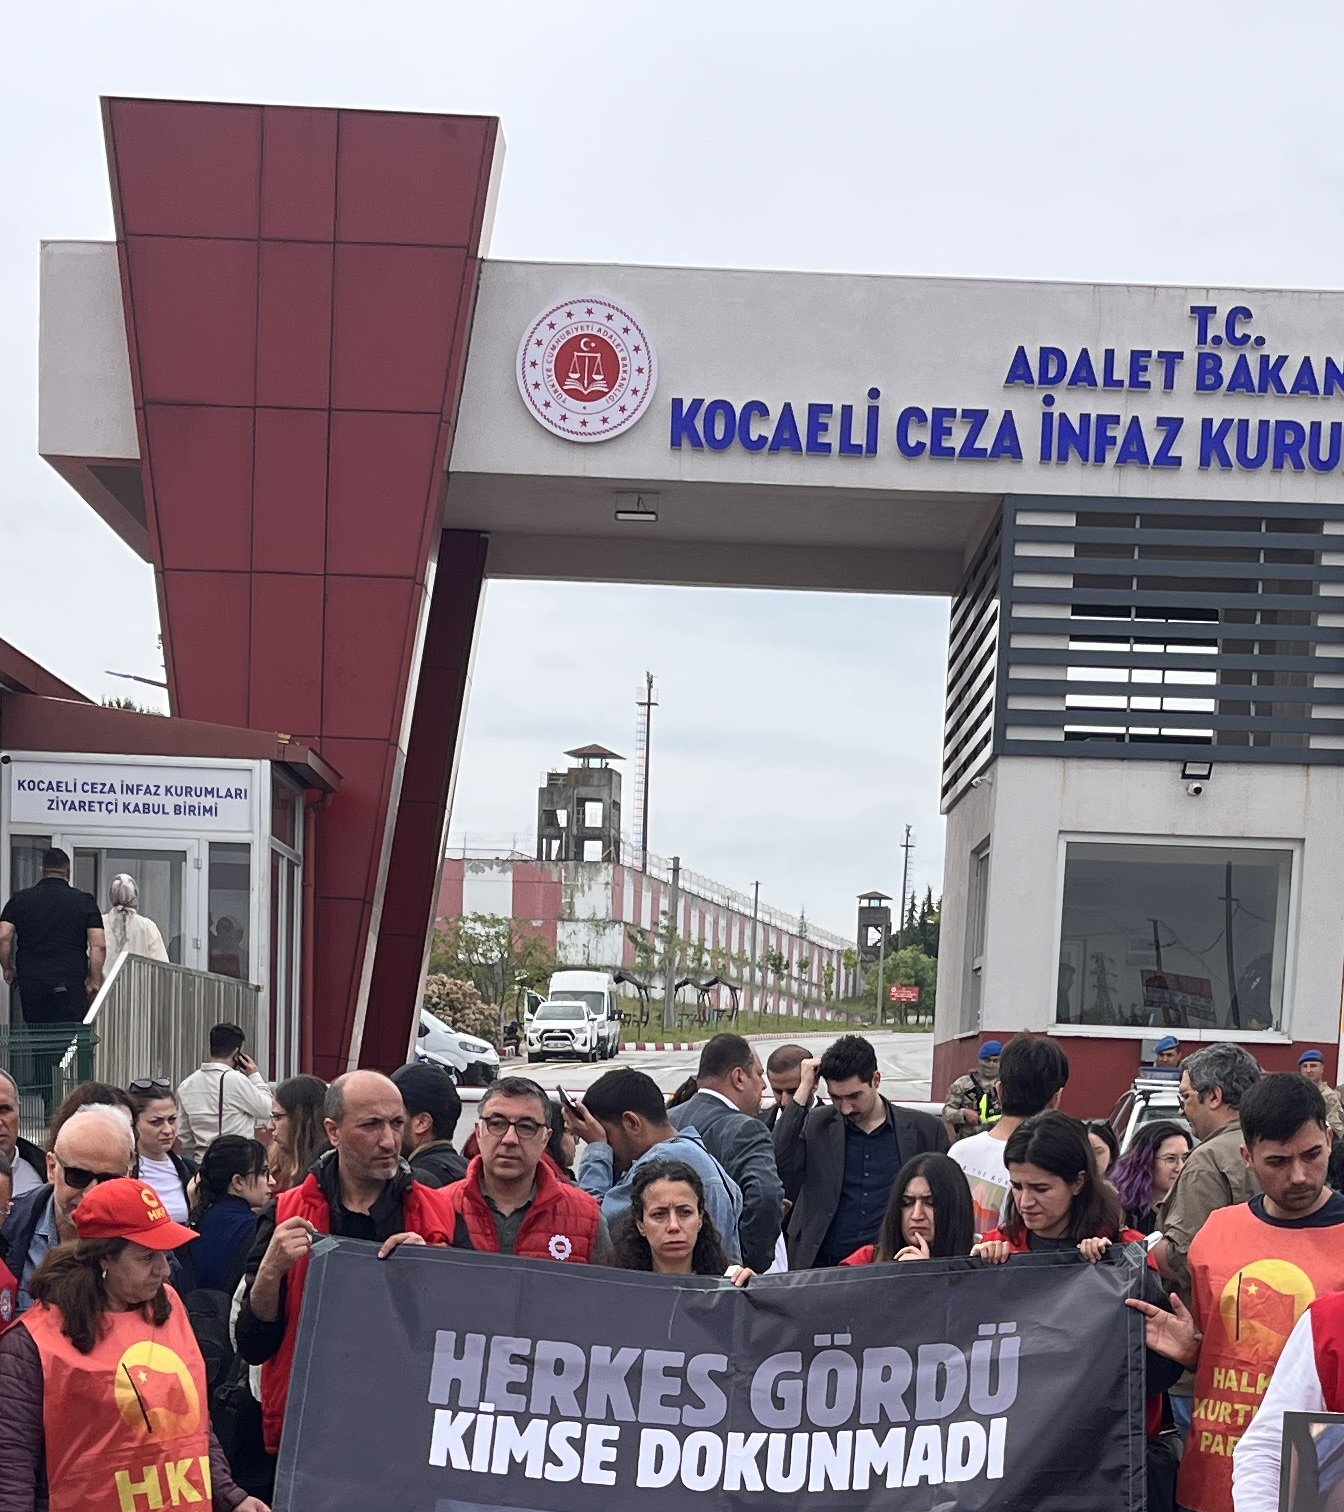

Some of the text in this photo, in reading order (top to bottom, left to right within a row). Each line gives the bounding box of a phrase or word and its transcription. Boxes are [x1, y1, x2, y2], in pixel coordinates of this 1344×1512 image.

[596, 327, 625, 354] ADALET
[1191, 306, 1265, 347] T.C.
[1004, 346, 1184, 392] ADALET
[670, 386, 880, 457] KOCAELİ
[896, 406, 1022, 460] CEZA
[1040, 394, 1184, 468] İNFAZ
[17, 777, 248, 801] KOCAELİ CEZA İNFAZ KURUMLARI
[47, 796, 219, 818] ZİYARETÇİ KABUL BİRİMİ
[427, 1321, 1022, 1431] HERKES GÖRDÜ
[428, 1402, 1008, 1493] KİMSE DOKUNMADI
